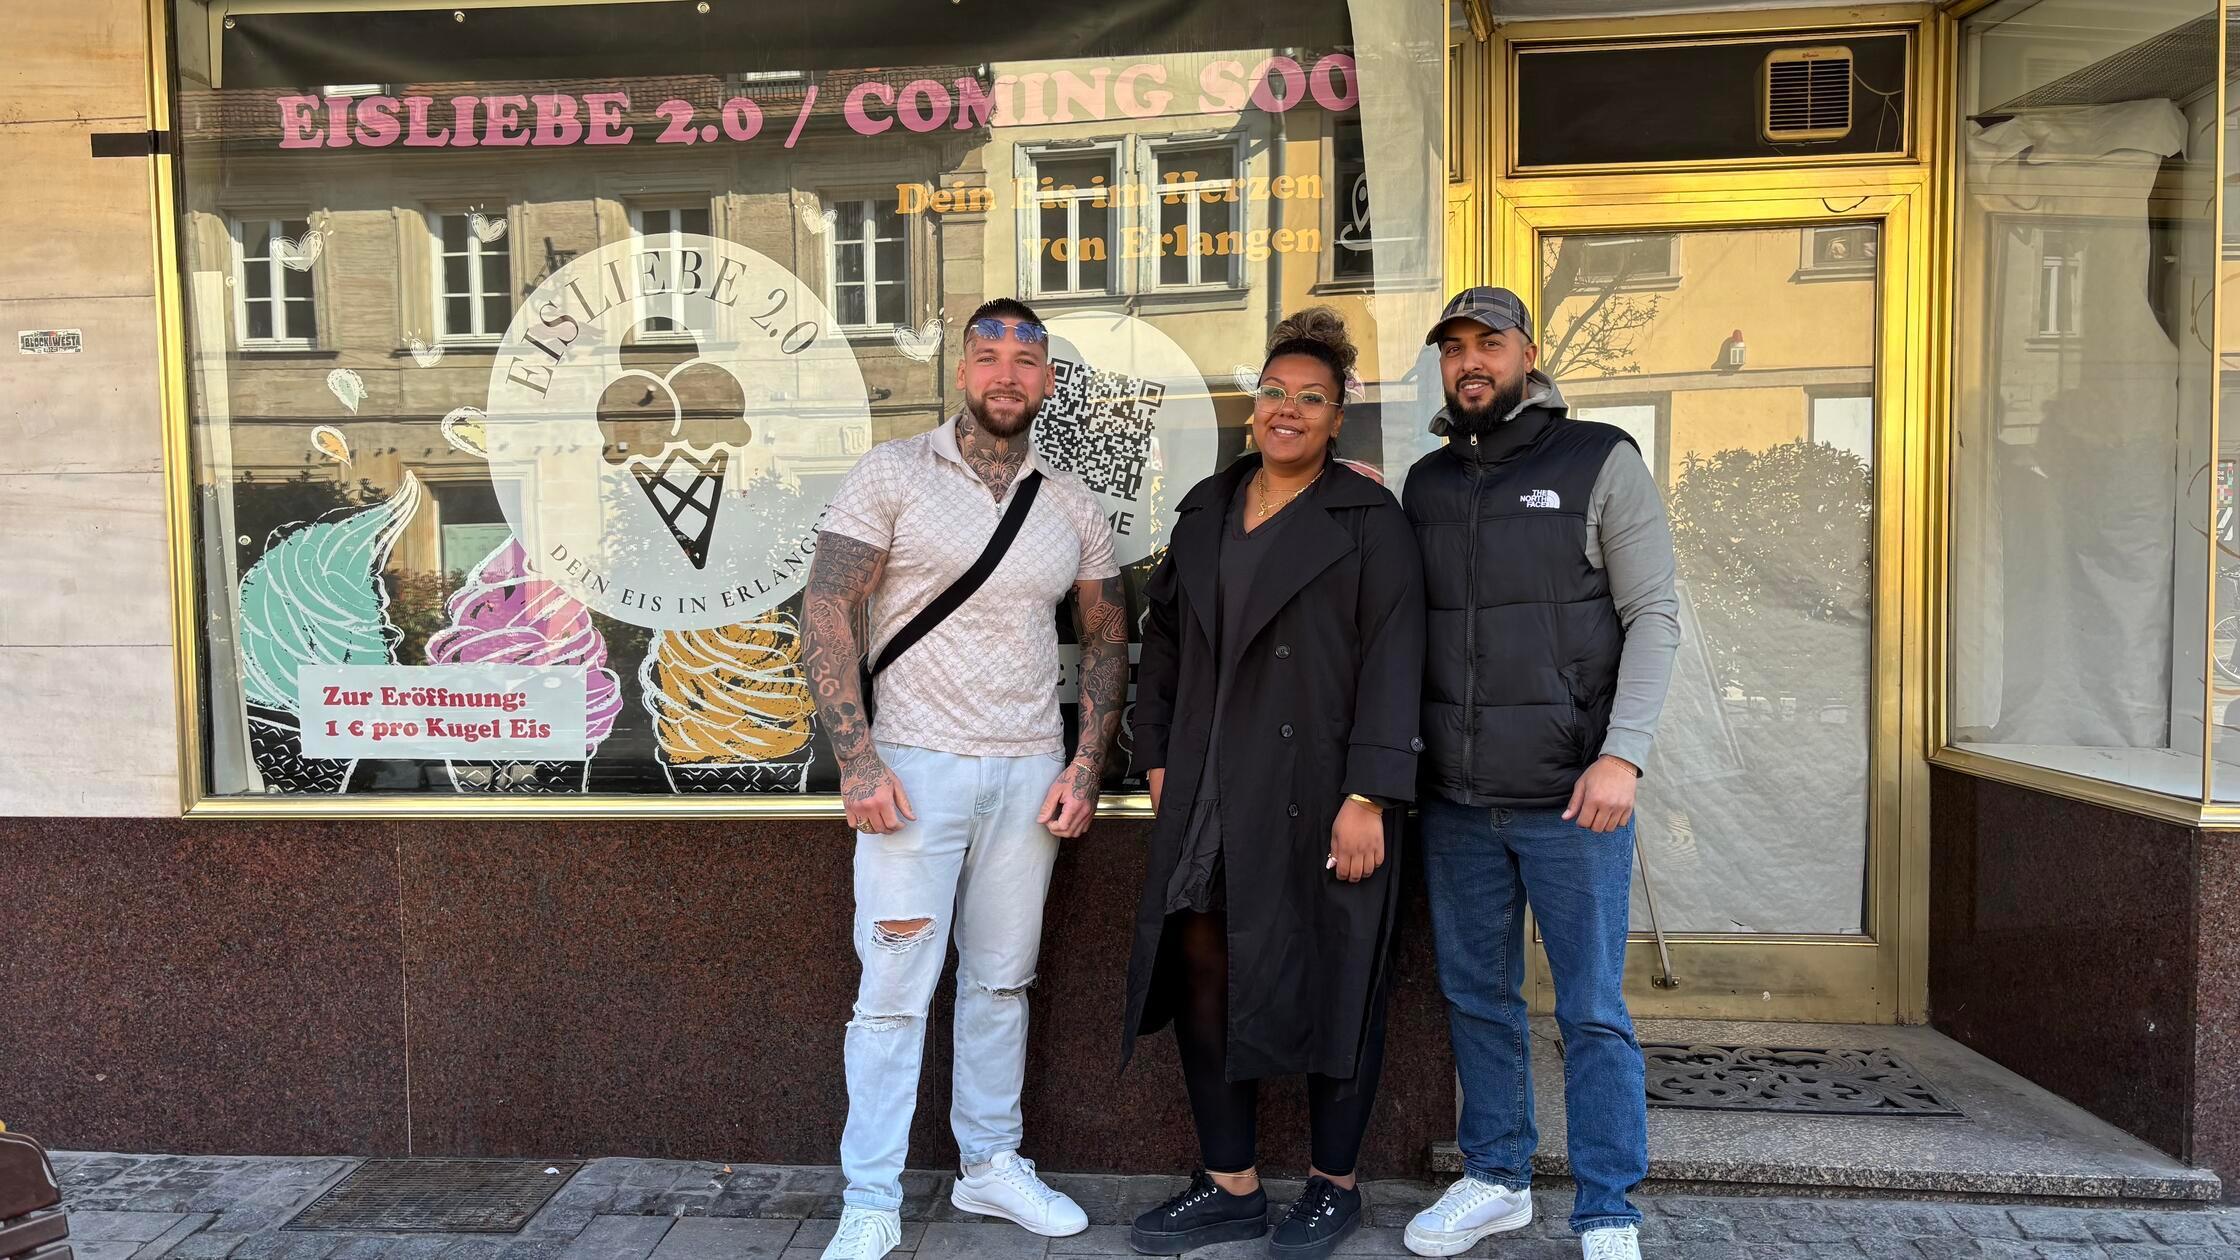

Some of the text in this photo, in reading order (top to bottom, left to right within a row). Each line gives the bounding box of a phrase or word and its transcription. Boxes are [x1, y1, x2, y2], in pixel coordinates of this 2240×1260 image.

[277, 91, 634, 149] EISLIEBE
[655, 96, 764, 146] 2.0
[784, 84, 819, 149] /
[843, 62, 1174, 136] COMING
[894, 170, 1325, 215] Dein Eis im Herzen
[1022, 224, 1323, 263] von Erlangen
[52, 335, 76, 347] WEST
[504, 249, 820, 400] EISLIEBE 2.0
[1531, 489, 1548, 497] THE
[549, 503, 832, 614] DEIN EIS IN ERLANG
[322, 686, 527, 712] Zur Eröffnung:
[325, 717, 551, 743] 1 € pro Kugel Eis
